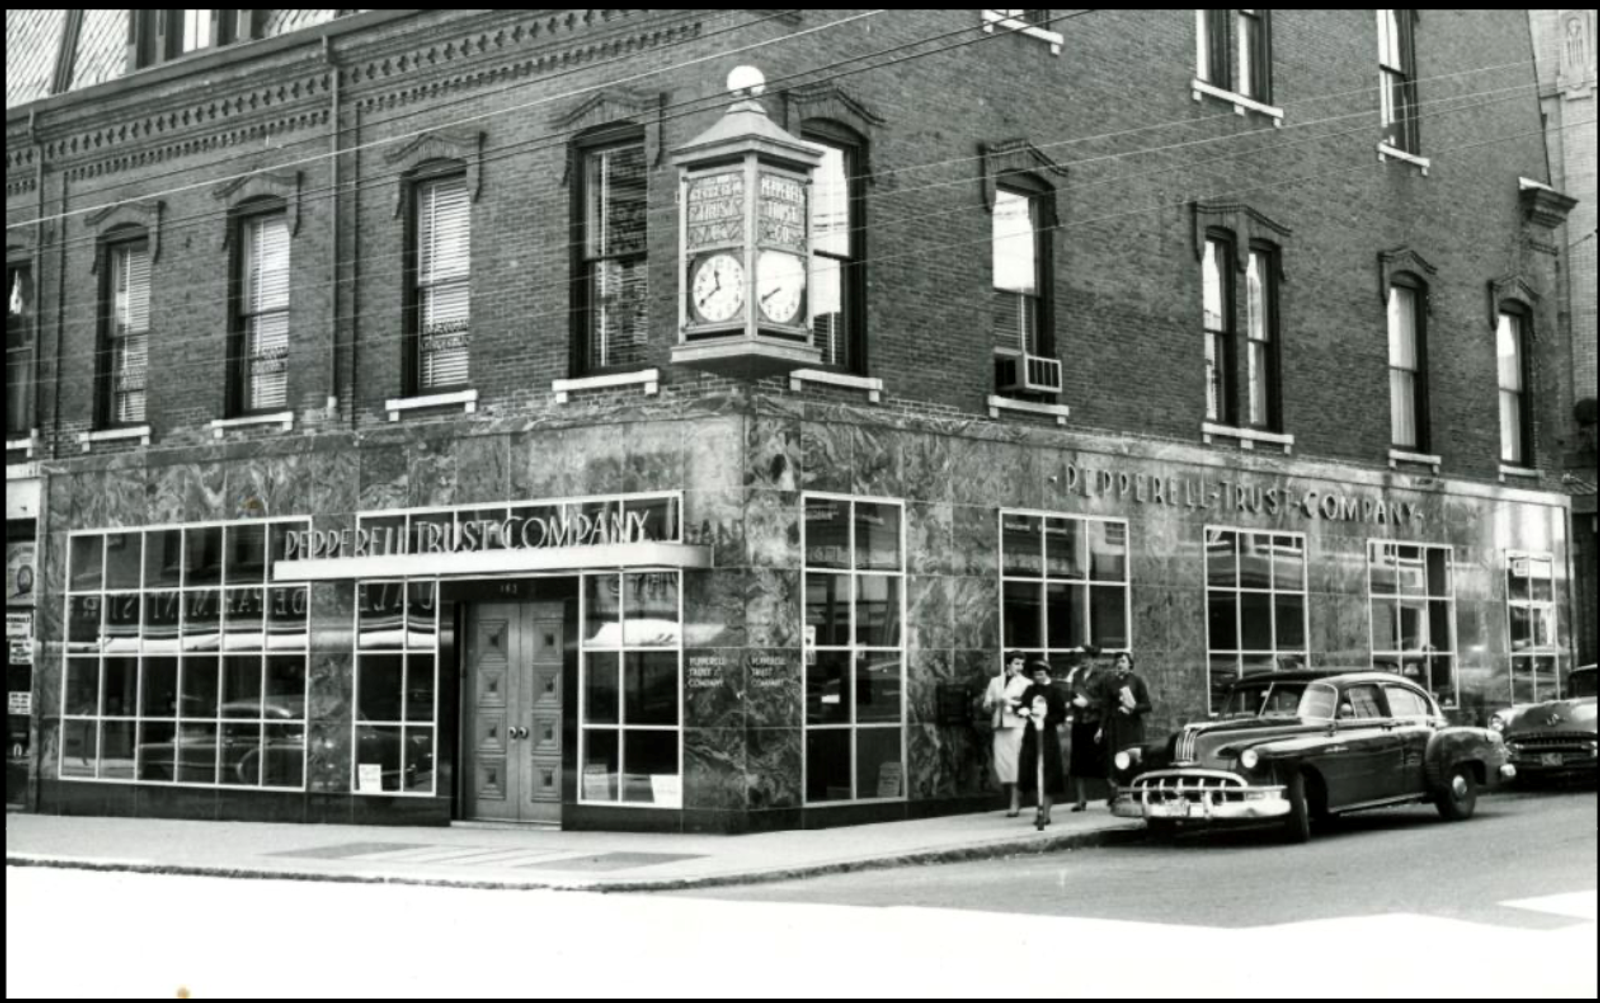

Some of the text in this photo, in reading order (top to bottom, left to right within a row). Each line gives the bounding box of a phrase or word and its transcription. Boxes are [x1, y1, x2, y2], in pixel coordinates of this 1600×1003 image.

[1057, 465, 1416, 526] PEPPERELL TRUST COMPANY
[284, 509, 649, 561] PEPPERELL TRUST COMPANY
